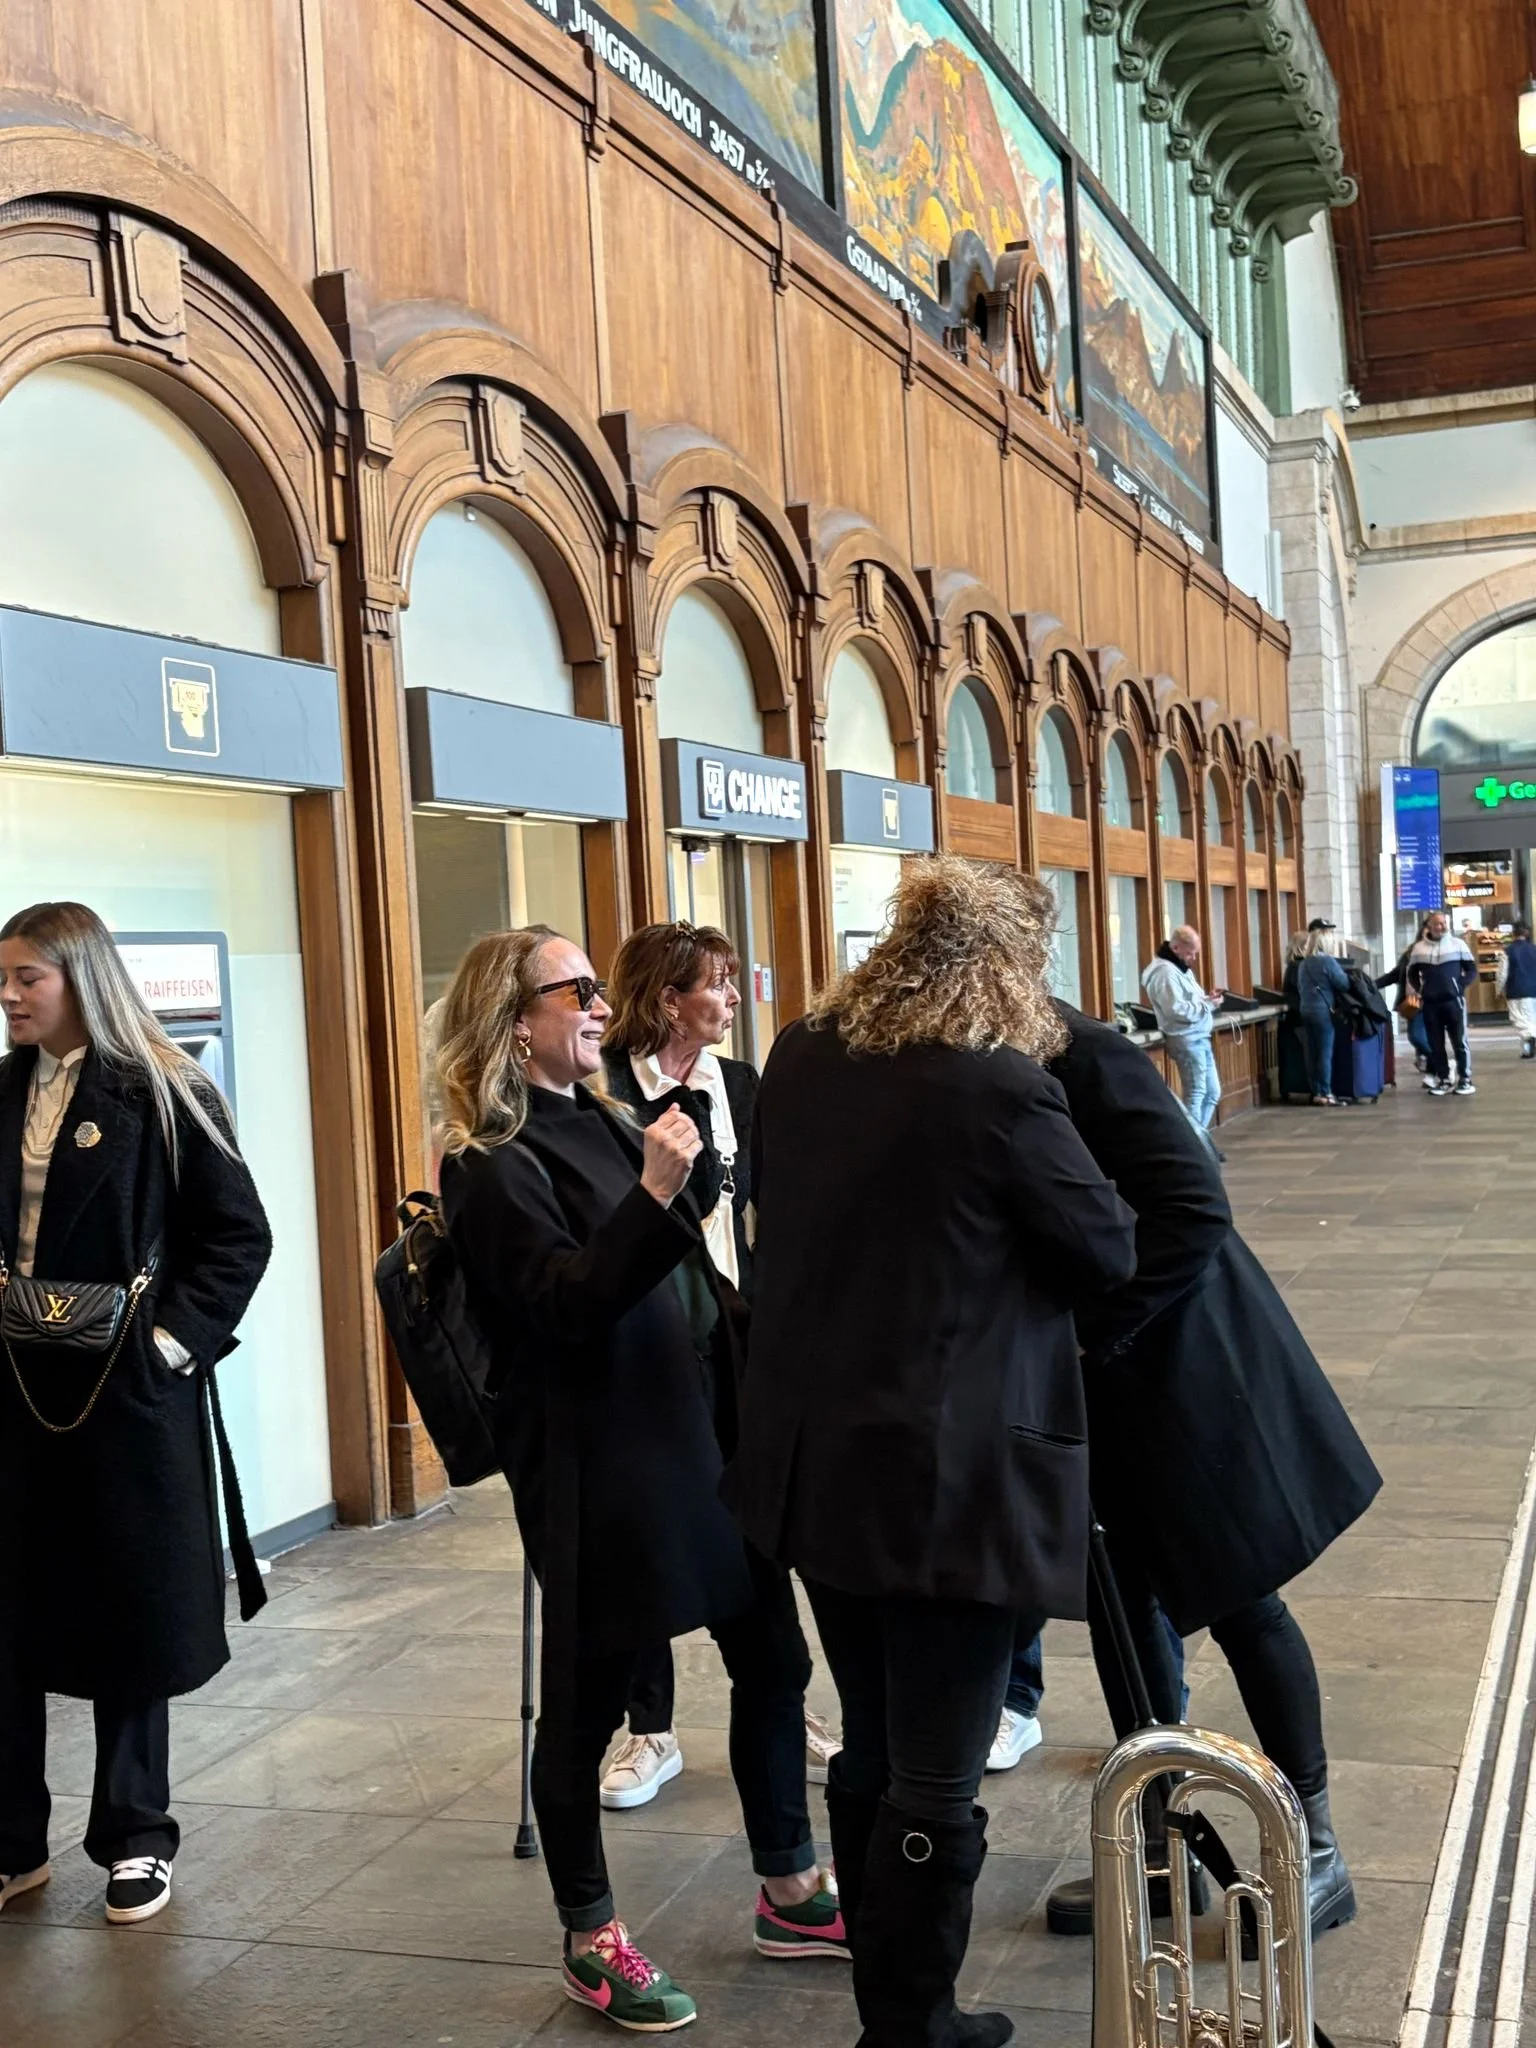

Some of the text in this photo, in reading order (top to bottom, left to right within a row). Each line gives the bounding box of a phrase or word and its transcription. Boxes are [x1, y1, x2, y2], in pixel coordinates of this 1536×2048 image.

[709, 120, 745, 171] 3457
[728, 769, 802, 819] CHANGE
[143, 979, 214, 998] RAIFFEISEN
[40, 1294, 77, 1323] LV
